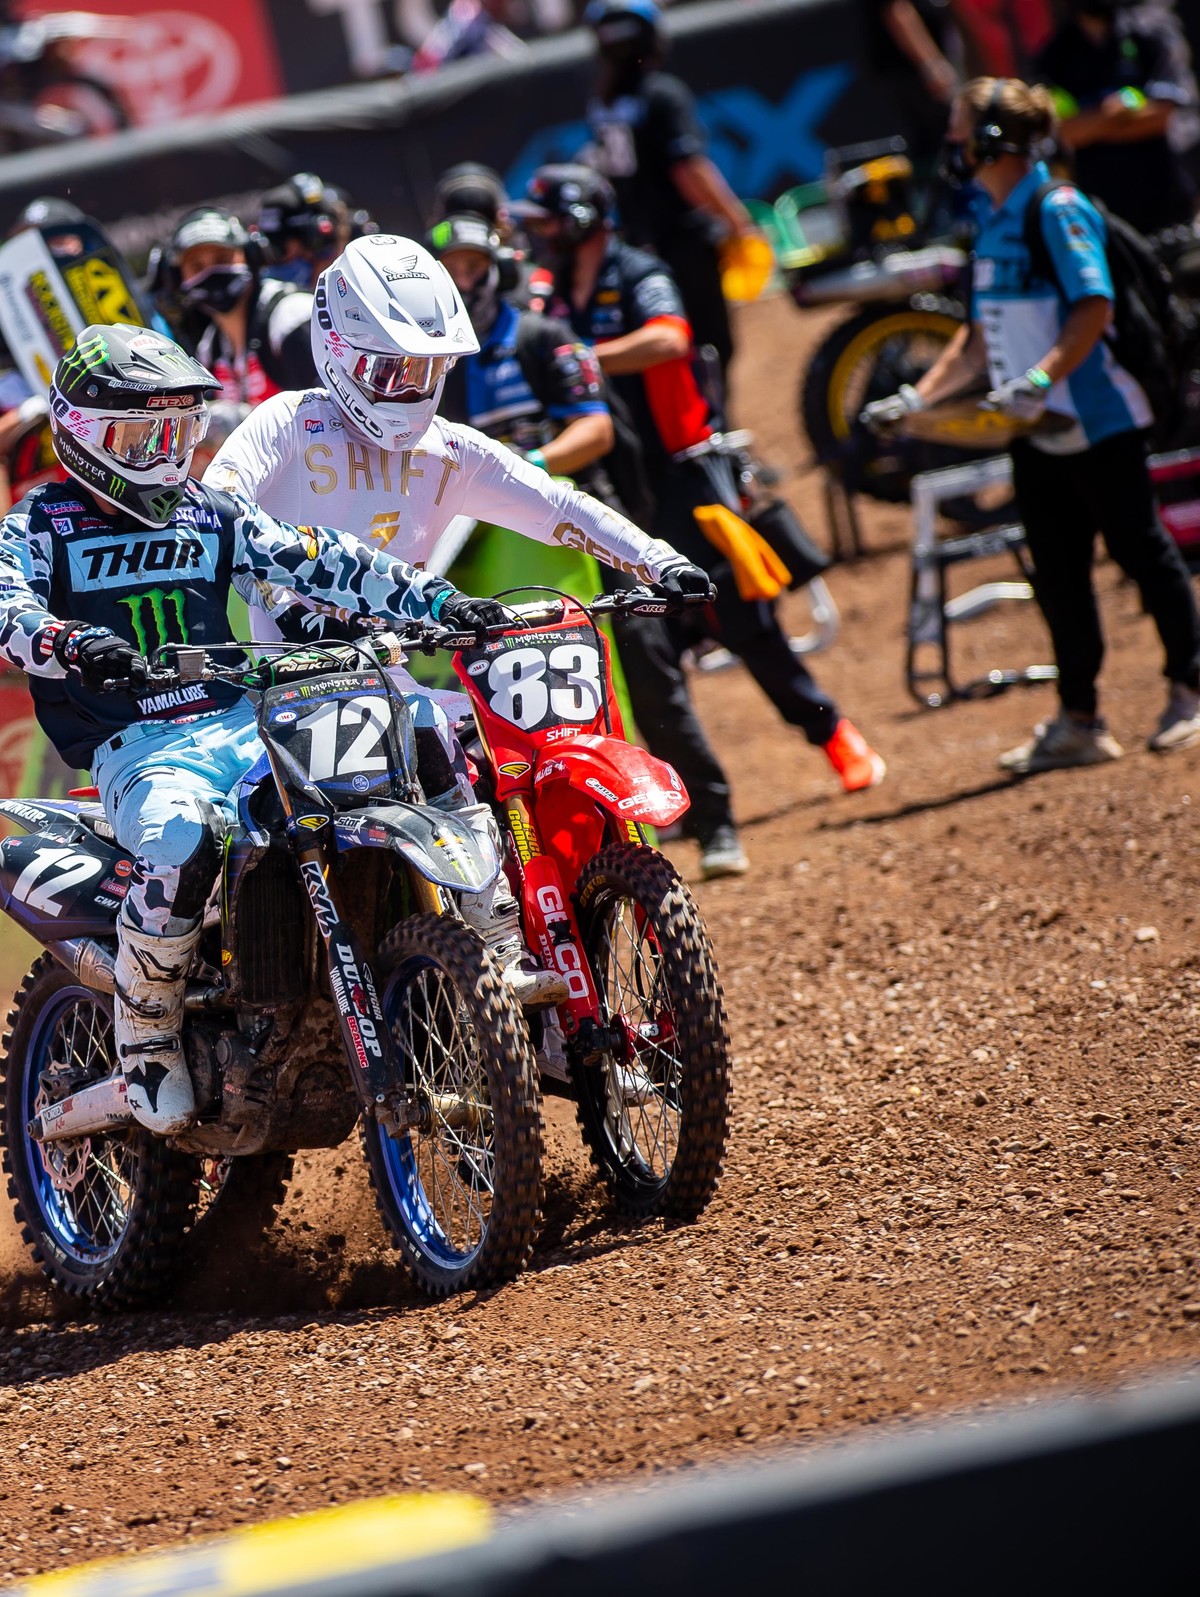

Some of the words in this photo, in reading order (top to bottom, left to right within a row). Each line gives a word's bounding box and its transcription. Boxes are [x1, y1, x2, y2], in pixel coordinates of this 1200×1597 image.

[388, 271, 429, 281] HONDA
[325, 361, 383, 438] GEICO
[59, 437, 106, 481] MONSTER
[304, 441, 460, 507] SHIFT
[164, 475, 178, 483] BELL
[81, 538, 205, 580] THOR
[633, 604, 667, 613] ARC
[443, 636, 477, 647] ARC
[515, 632, 563, 644] MONSTER
[137, 684, 208, 715] YAMALUBE
[310, 677, 360, 692] MONSTER
[487, 644, 602, 731] 83
[296, 695, 392, 782] 12
[546, 727, 581, 742] SHIFT
[618, 790, 683, 810] GEO
[11, 847, 103, 918] 12
[536, 885, 590, 999] GECO
[329, 965, 351, 1017] YAMALUBE
[366, 983, 383, 1021] CYCRA
[346, 1016, 369, 1069] BRAKING
[639, 1023, 660, 1037] 83
